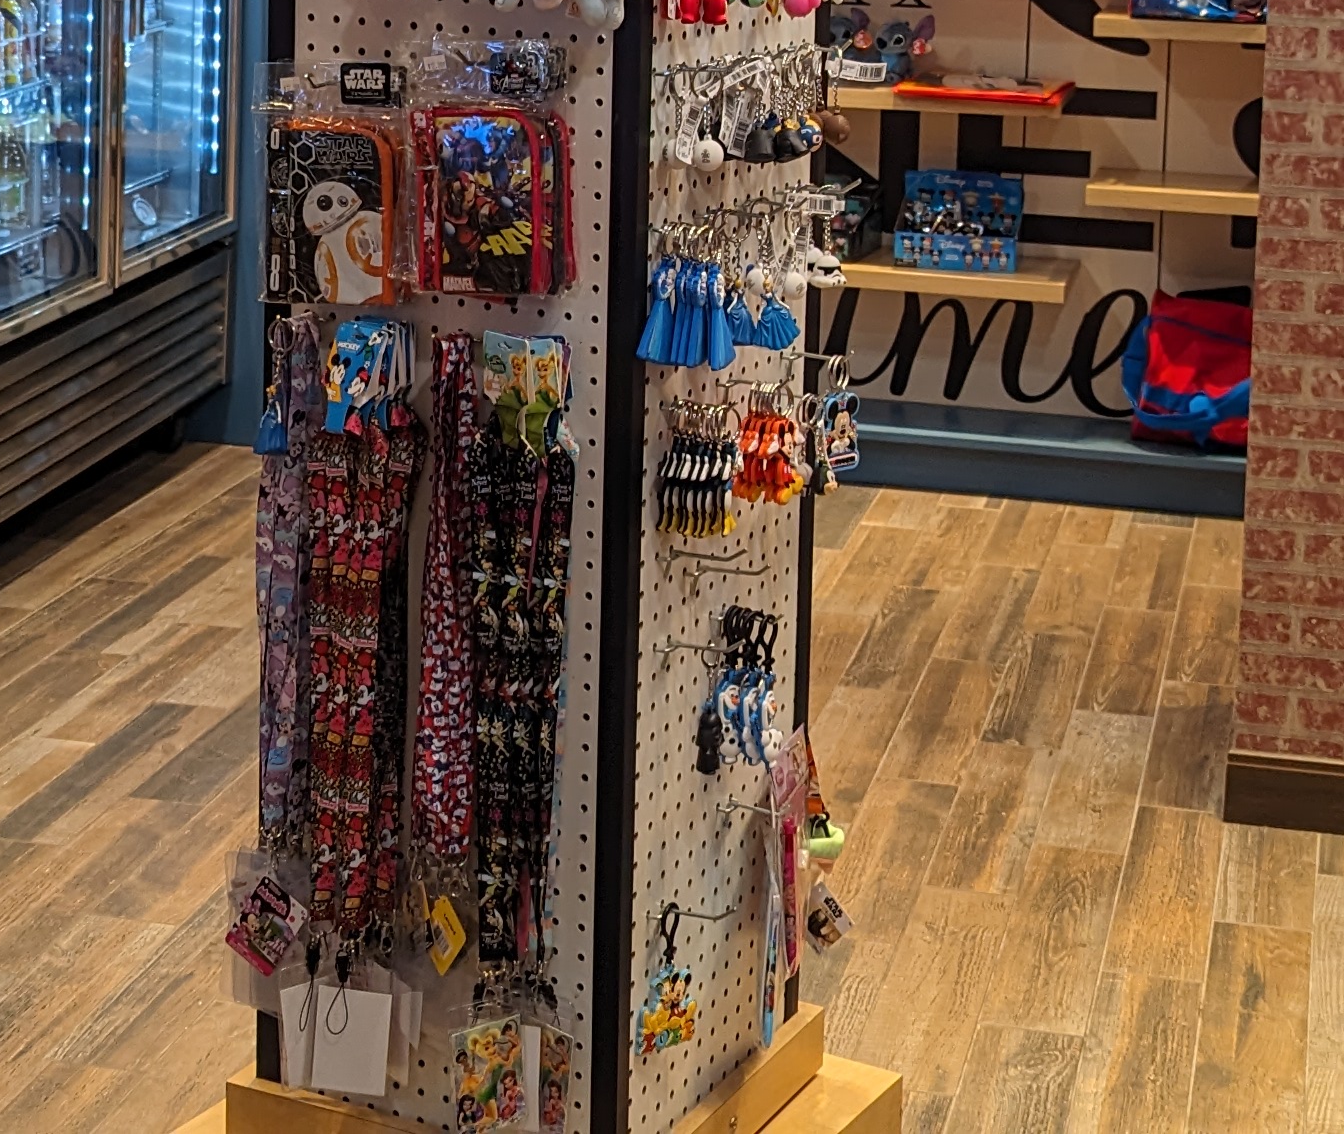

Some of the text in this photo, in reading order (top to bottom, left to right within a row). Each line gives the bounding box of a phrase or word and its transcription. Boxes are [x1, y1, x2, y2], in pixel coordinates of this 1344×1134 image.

[346, 69, 385, 80] STAR
[344, 78, 386, 90] WARS
[316, 136, 372, 151] STAR
[316, 148, 375, 164] WARS
[443, 276, 476, 292] MARVEL
